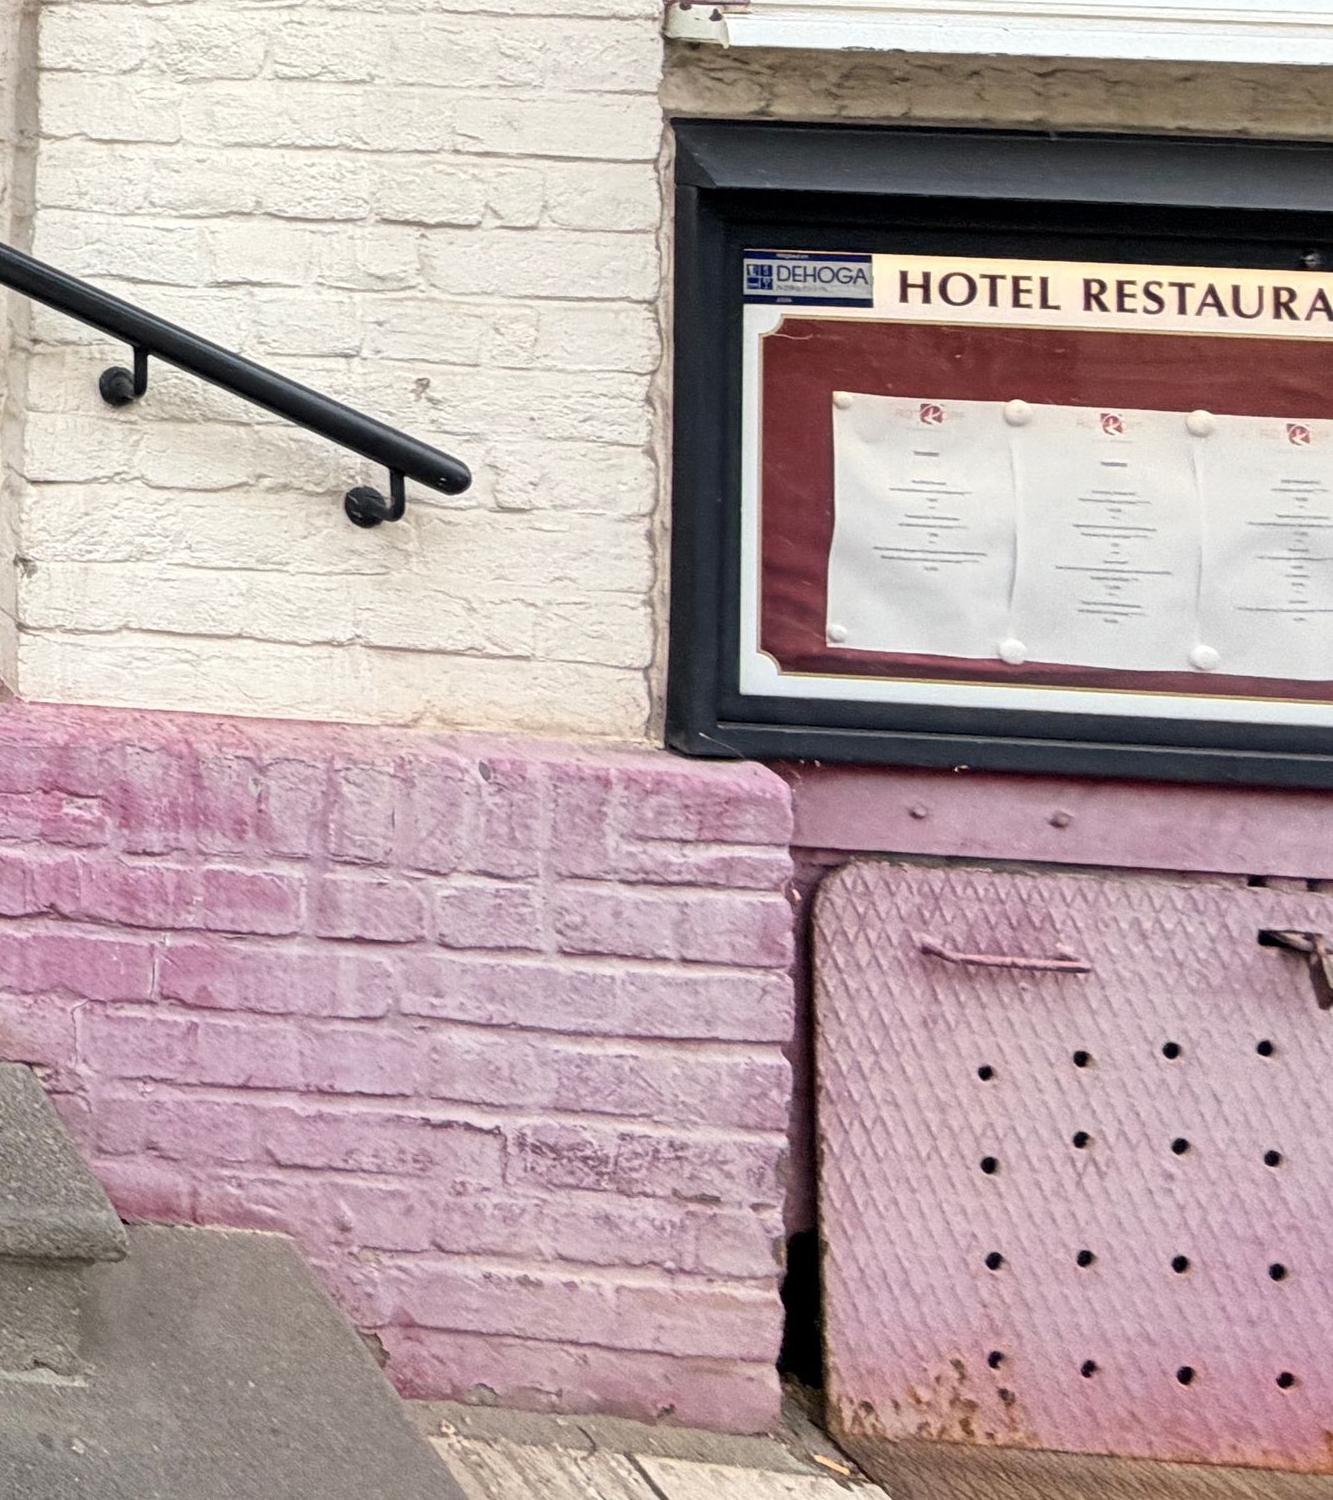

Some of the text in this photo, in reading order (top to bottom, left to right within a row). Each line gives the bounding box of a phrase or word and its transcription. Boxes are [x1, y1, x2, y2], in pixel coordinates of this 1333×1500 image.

[776, 264, 870, 285] DEHOGA
[898, 269, 1333, 323] HOTEL RESTAURA
